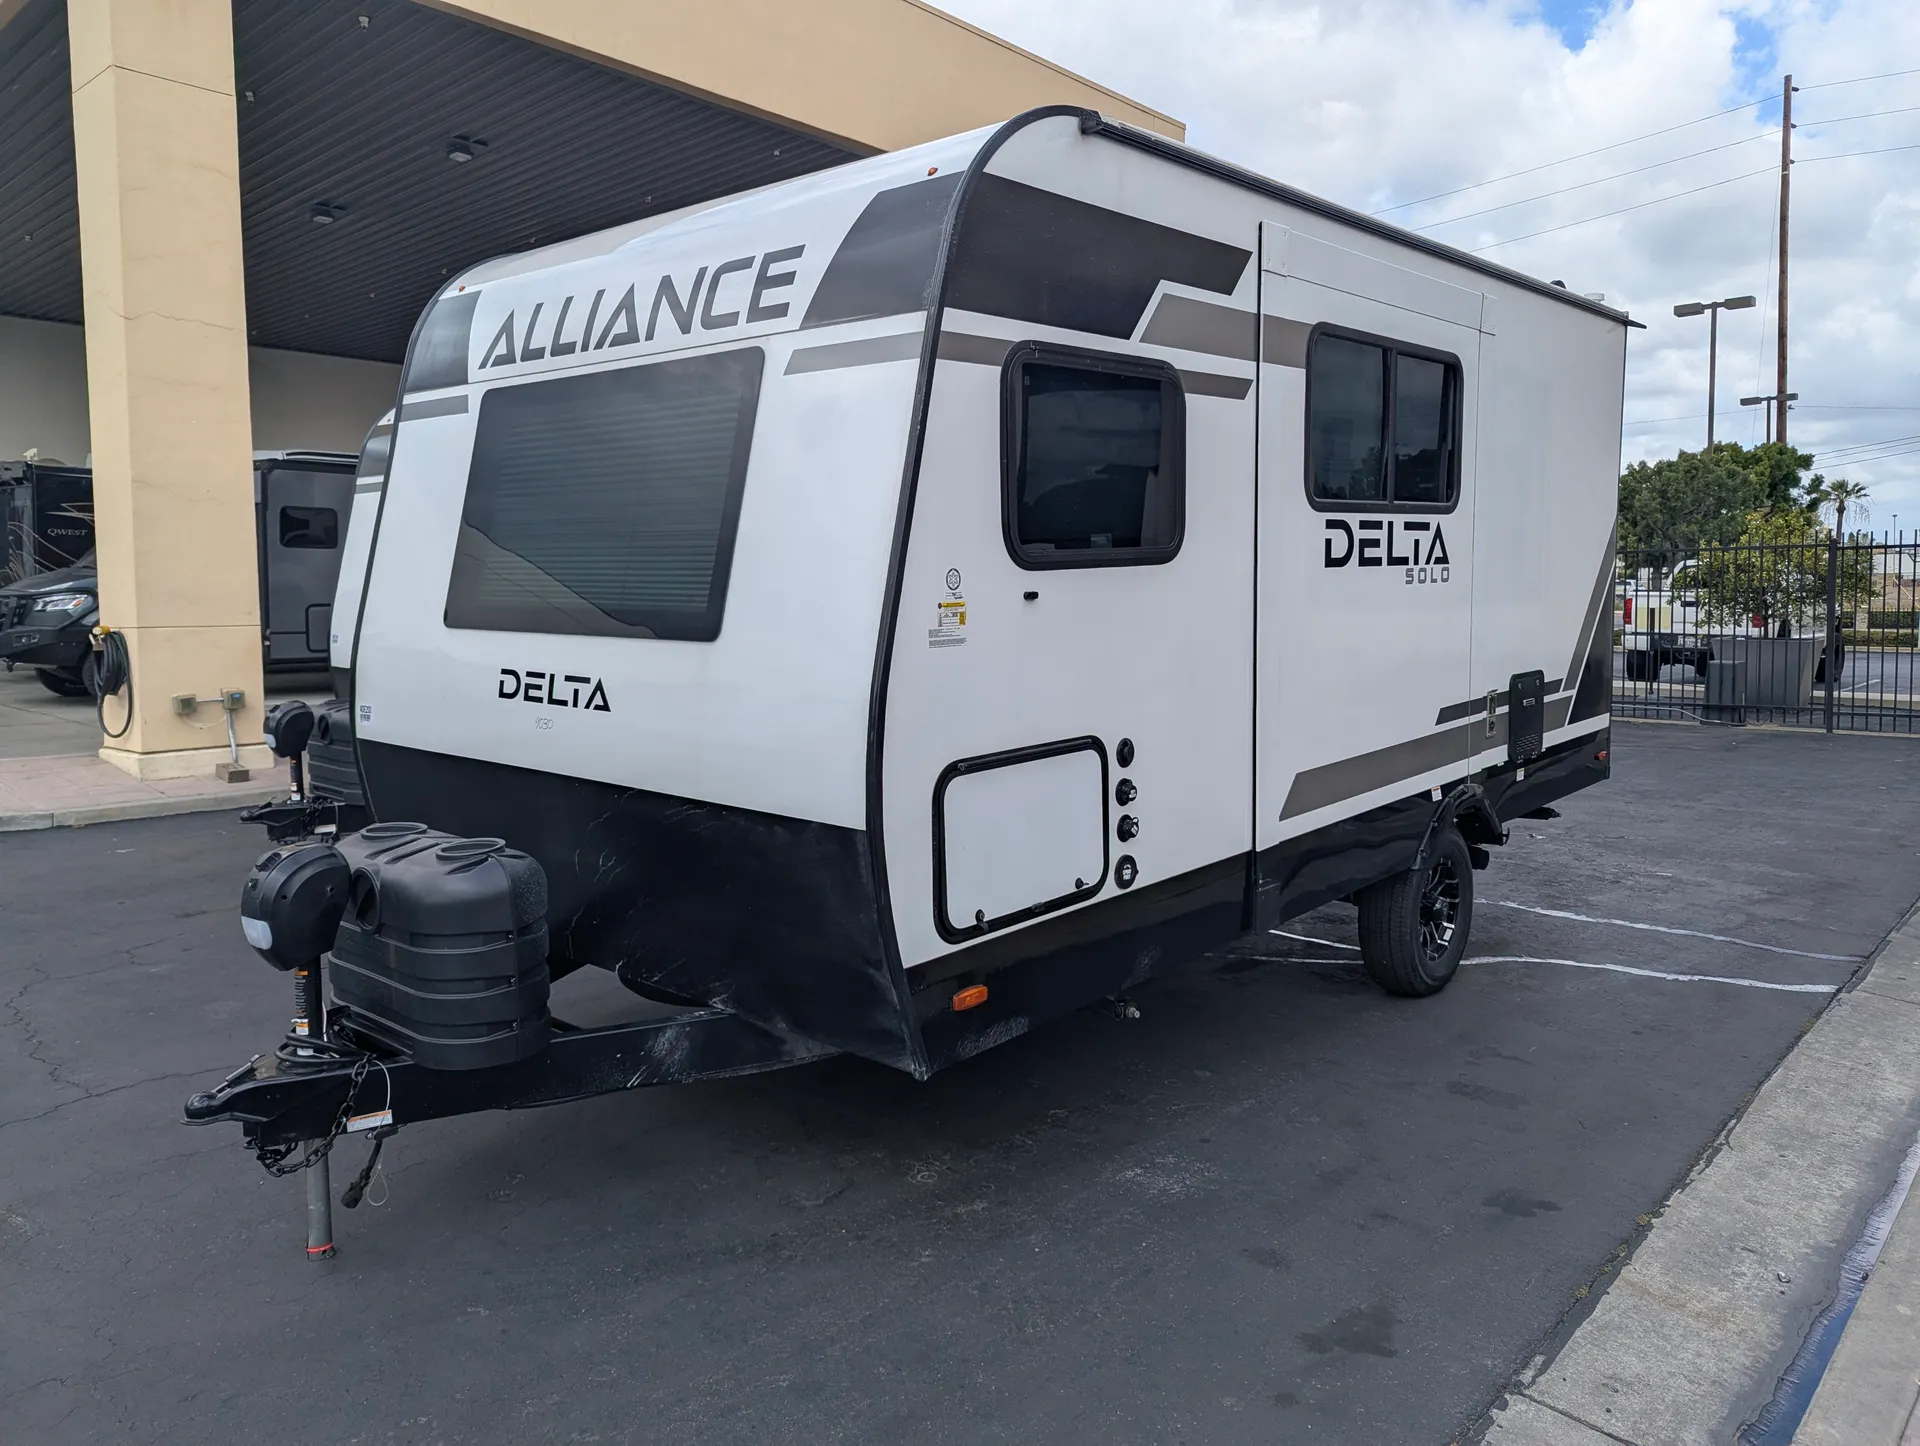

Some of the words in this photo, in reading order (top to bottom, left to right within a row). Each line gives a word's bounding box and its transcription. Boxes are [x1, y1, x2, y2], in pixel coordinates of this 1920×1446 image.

[479, 244, 806, 369] ALLIANCE
[47, 528, 88, 536] QWEST
[1325, 519, 1450, 568] DELTA
[1405, 567, 1450, 584] SOLO
[498, 669, 612, 712] DELTA
